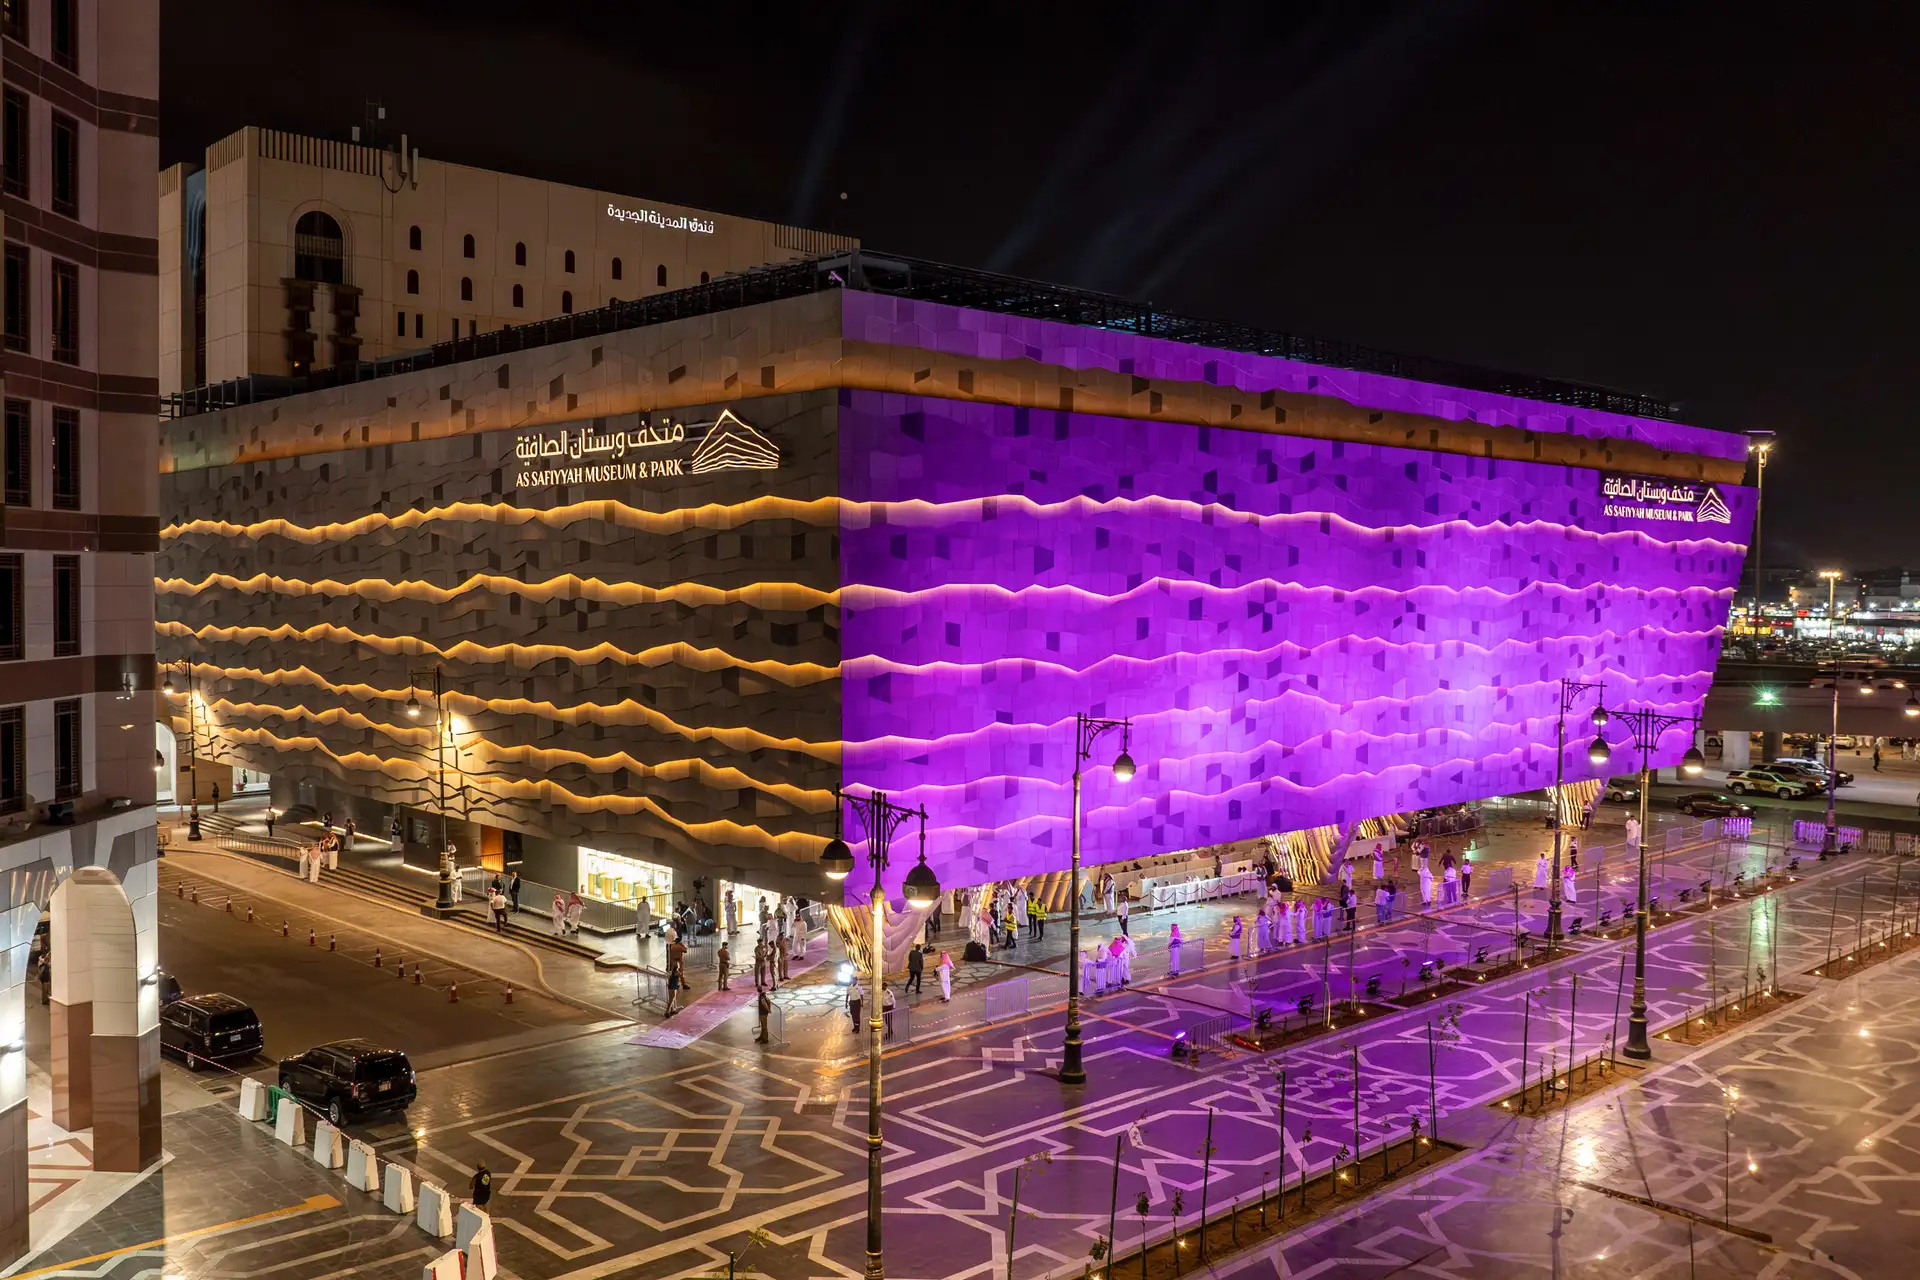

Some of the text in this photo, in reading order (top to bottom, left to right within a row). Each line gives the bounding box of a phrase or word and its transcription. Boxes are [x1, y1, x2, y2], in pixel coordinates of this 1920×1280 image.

[607, 204, 714, 234] فندق المدينة الجديدة
[570, 427, 625, 460] وبستان
[627, 418, 685, 448] متحف
[515, 458, 684, 488] AS SAFIYYAH MUSEUM & PARK
[1636, 481, 1666, 505] وبستان
[1667, 485, 1694, 502] متحف
[1603, 504, 1694, 522] AS SAFIYYAH MUSEUM & PARK
